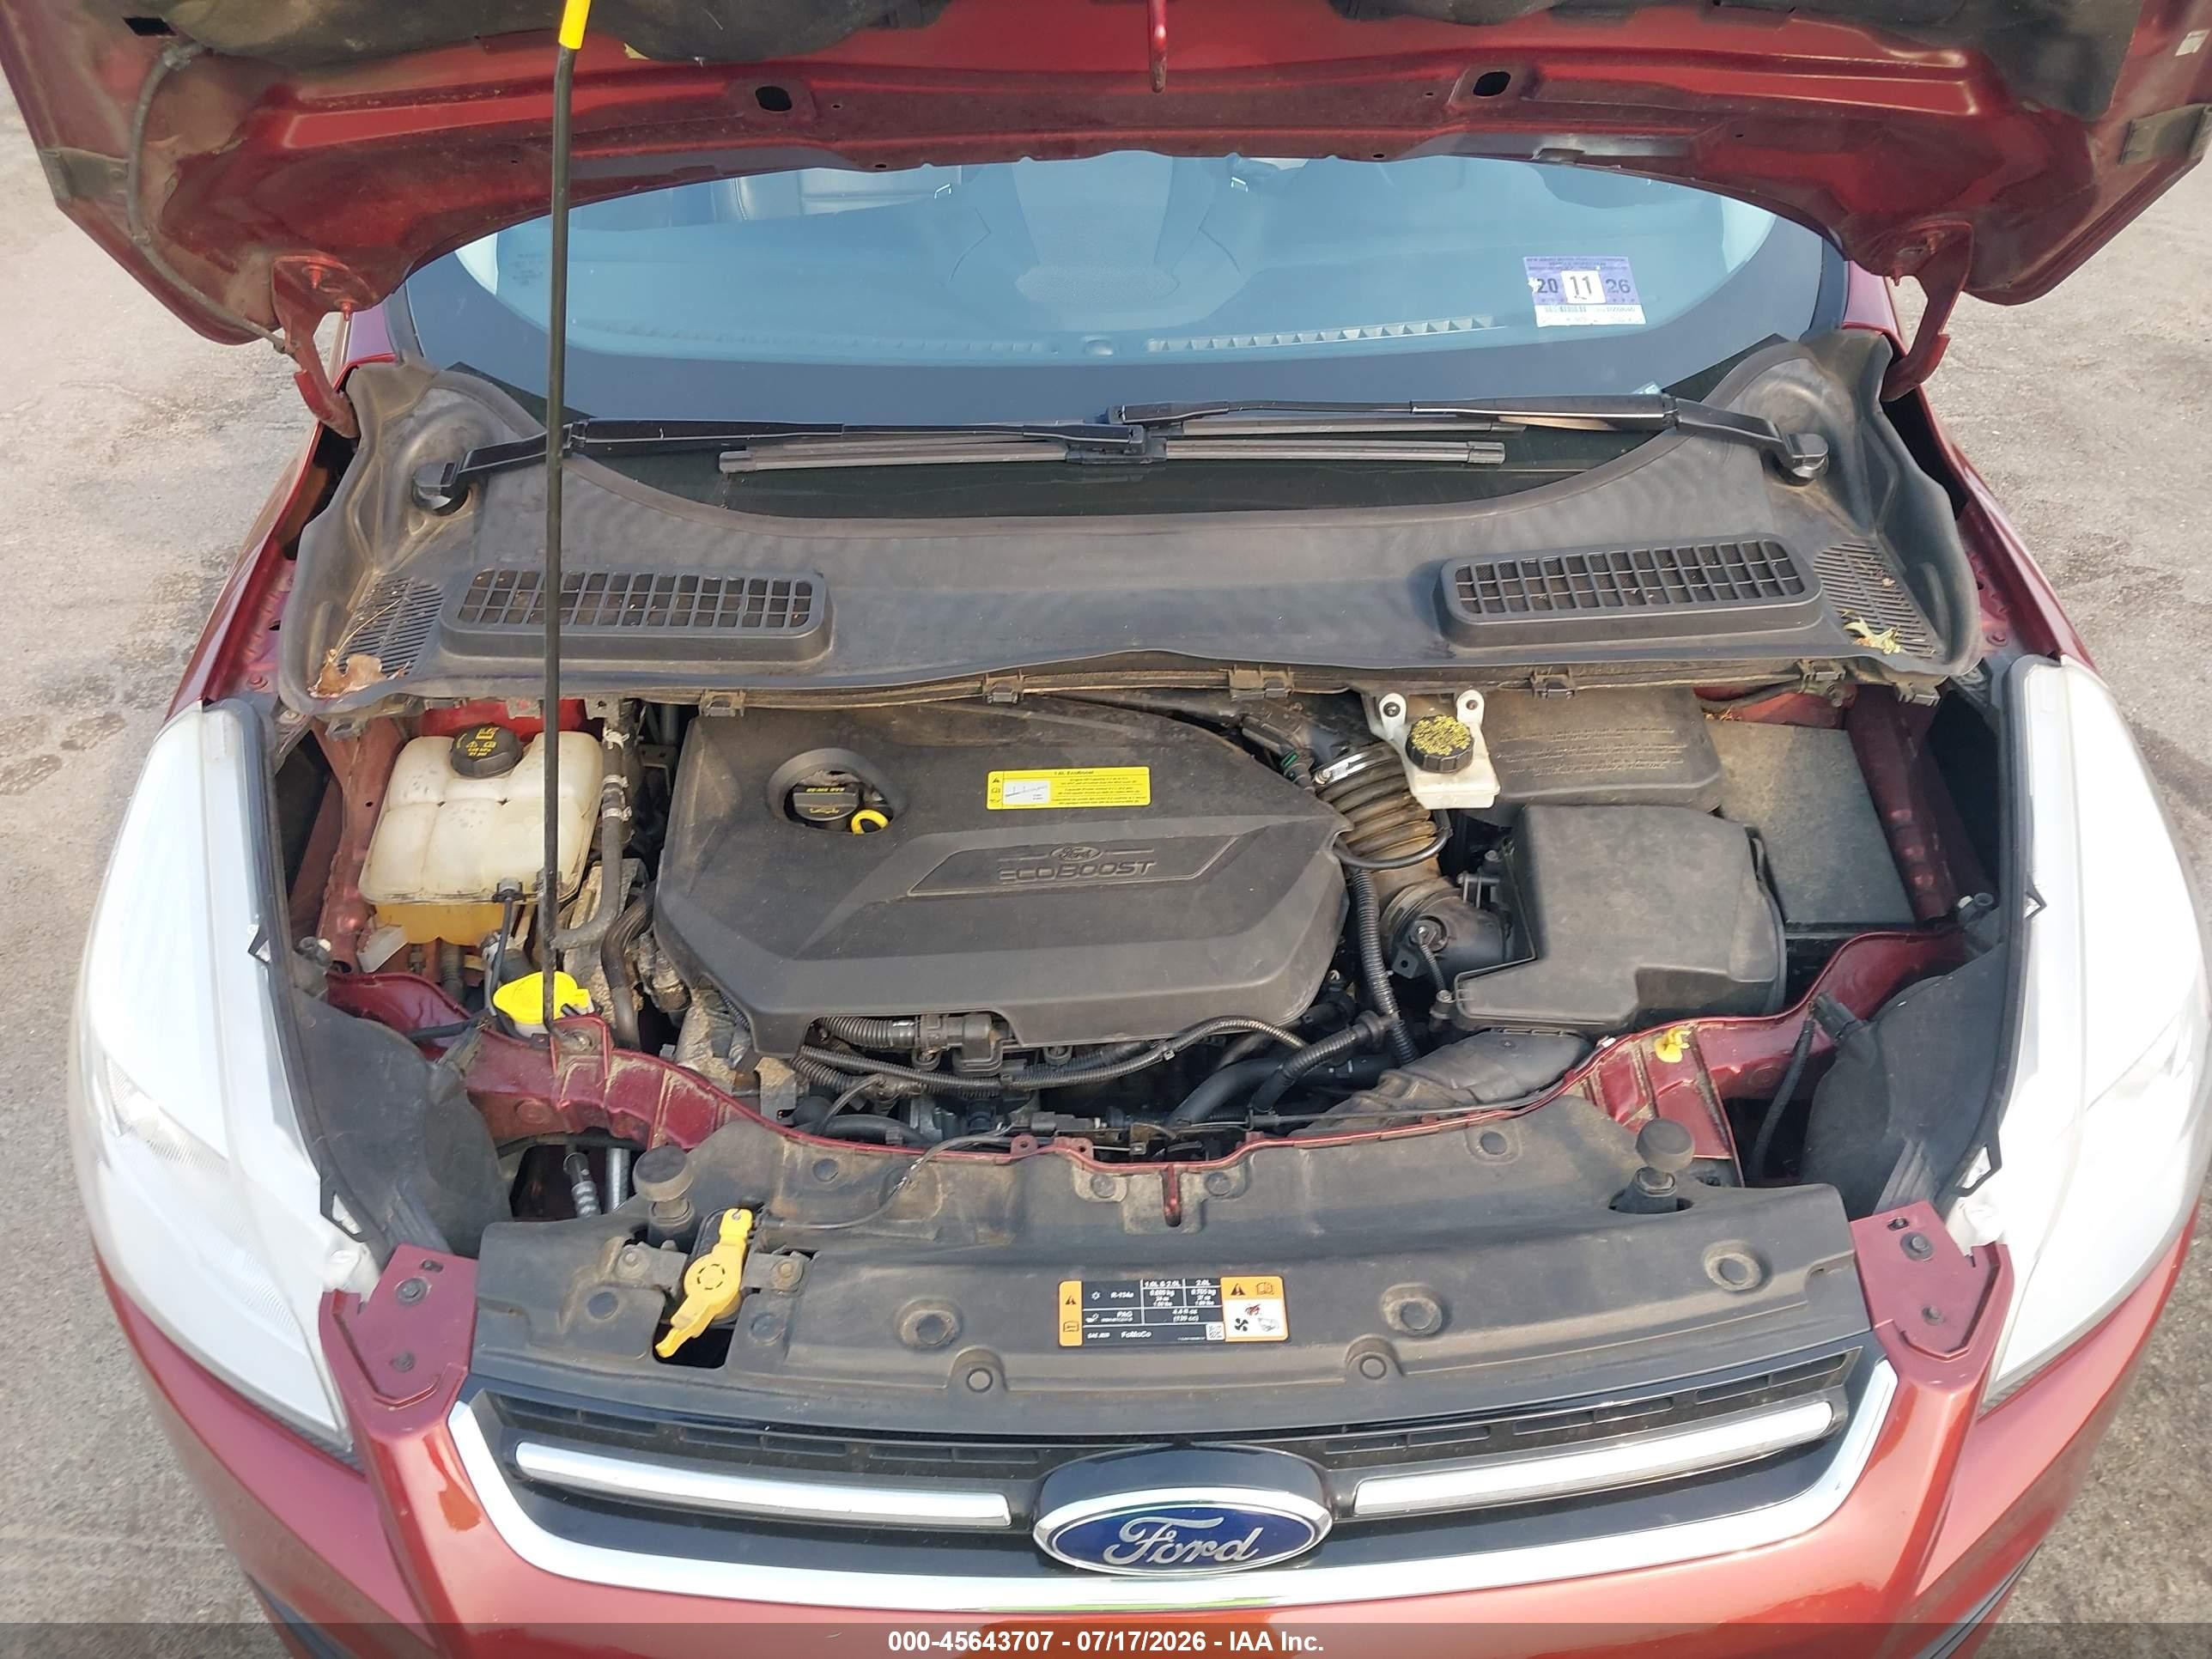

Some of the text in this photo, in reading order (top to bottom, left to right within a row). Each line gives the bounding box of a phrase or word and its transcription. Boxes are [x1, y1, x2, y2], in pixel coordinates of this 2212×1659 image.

[1537, 275, 1632, 295] 20 11 26
[1058, 847, 1091, 860] Ford
[998, 860, 1156, 882] ECOBOOST
[1102, 1515, 1264, 1566] Ford
